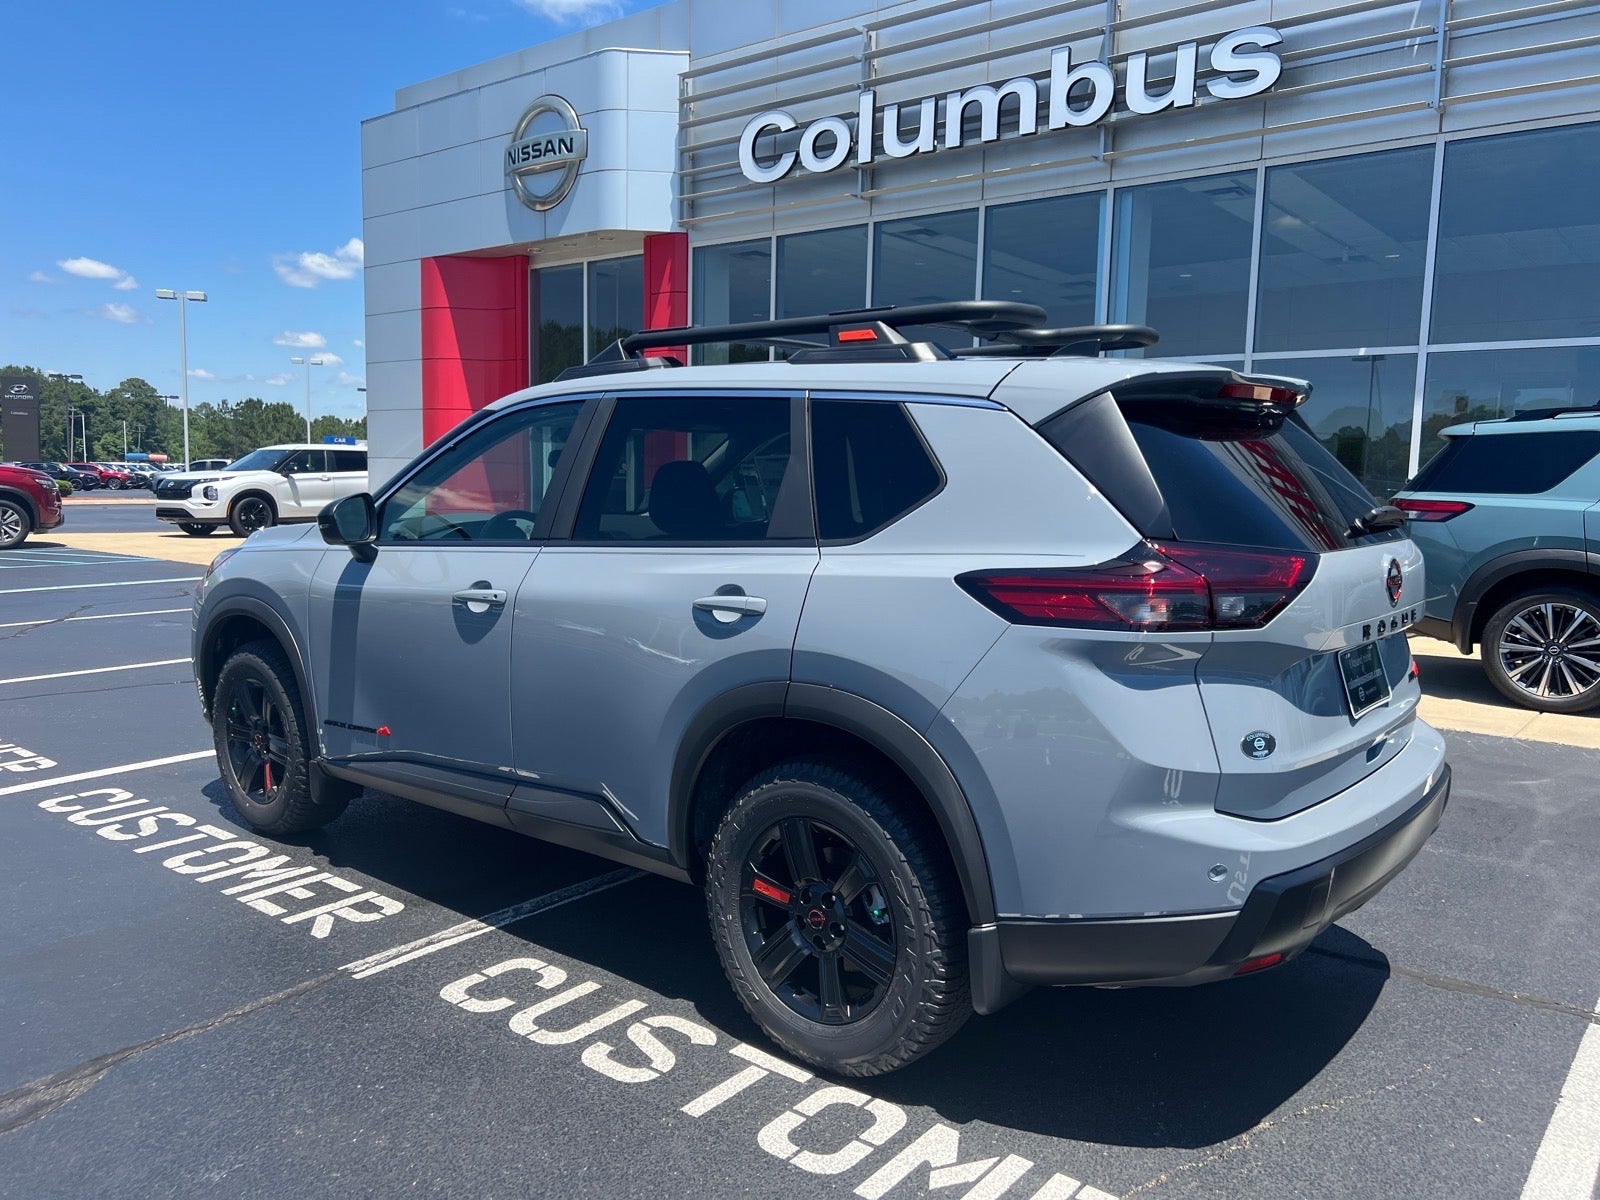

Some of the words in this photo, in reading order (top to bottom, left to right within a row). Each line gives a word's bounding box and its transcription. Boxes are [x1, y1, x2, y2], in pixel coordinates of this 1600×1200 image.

[738, 25, 1284, 184] Columbus
[508, 137, 574, 166] NISSAN
[1362, 609, 1417, 641] ROGUE
[37, 788, 405, 939] CUSTOMER
